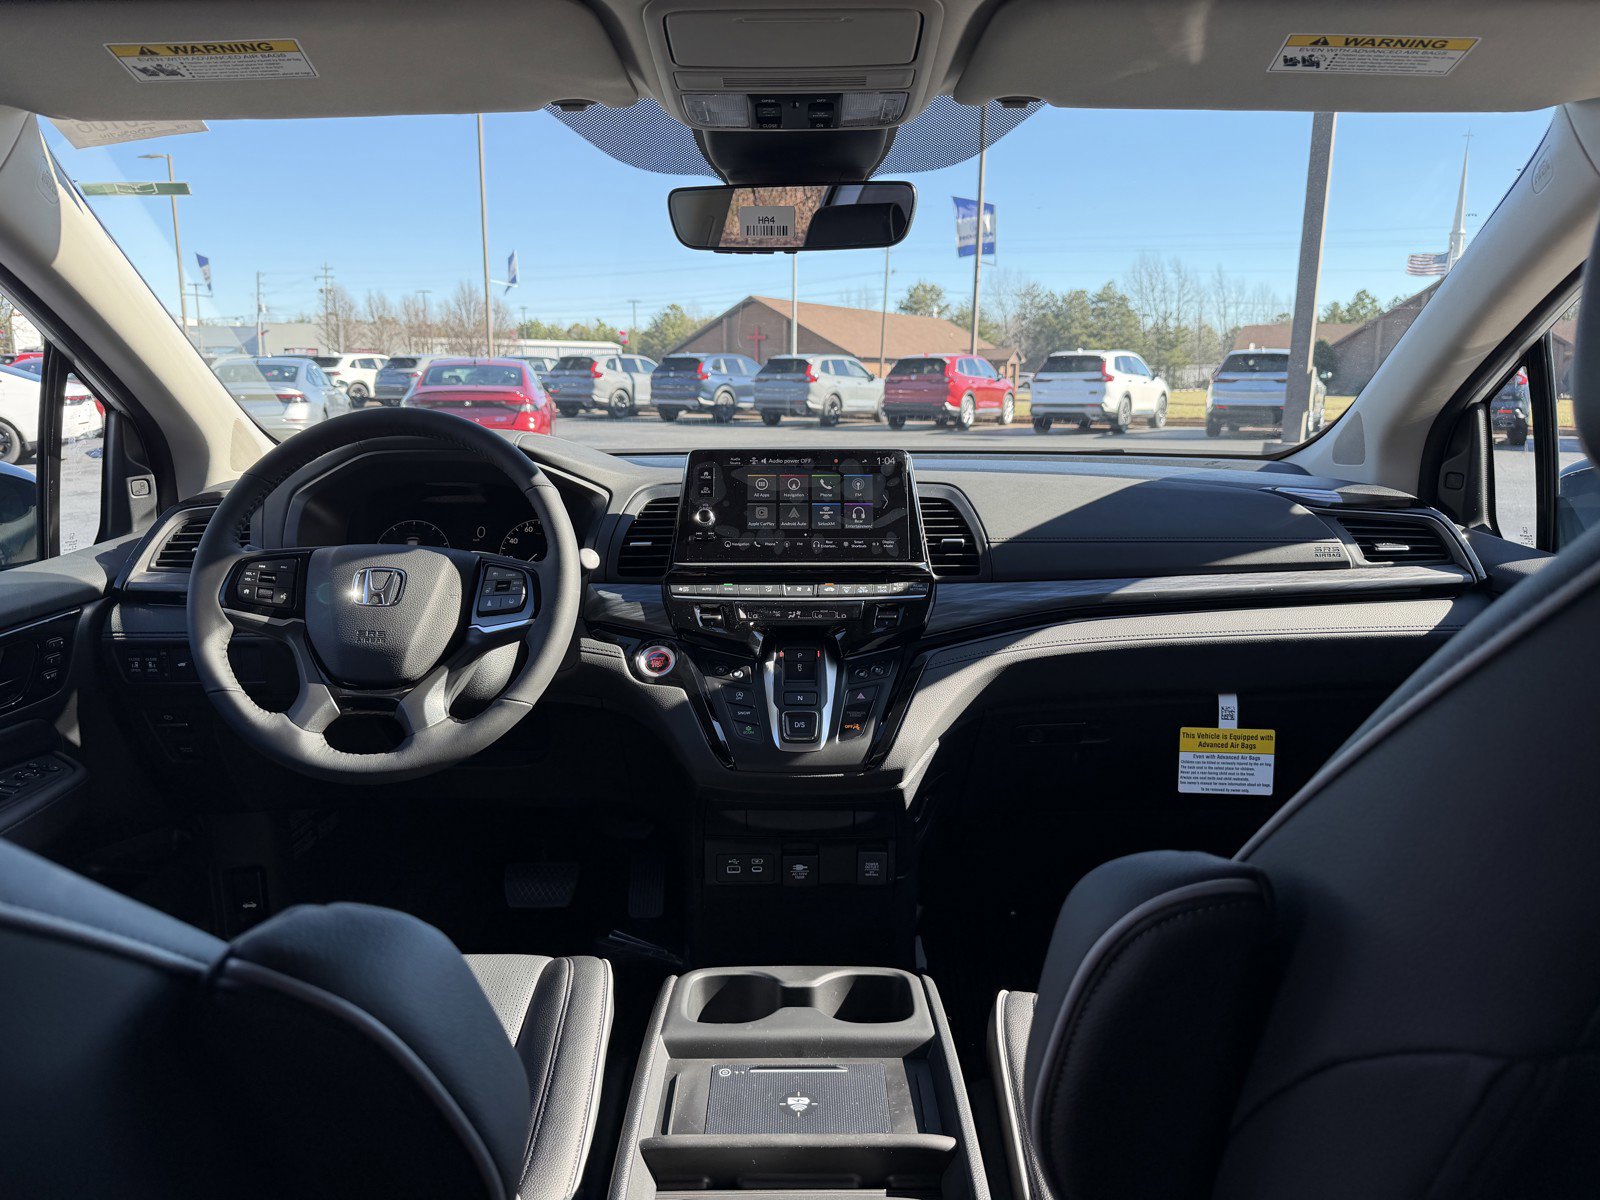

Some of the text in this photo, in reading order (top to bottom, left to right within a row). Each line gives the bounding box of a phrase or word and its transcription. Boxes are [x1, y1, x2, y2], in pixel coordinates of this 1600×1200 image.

[1344, 37, 1449, 49] WARNING
[166, 42, 274, 55] WARNING
[758, 216, 775, 224] HA4
[477, 526, 485, 538] 0
[1230, 733, 1258, 741] Equipped
[1241, 742, 1256, 750] Bags
